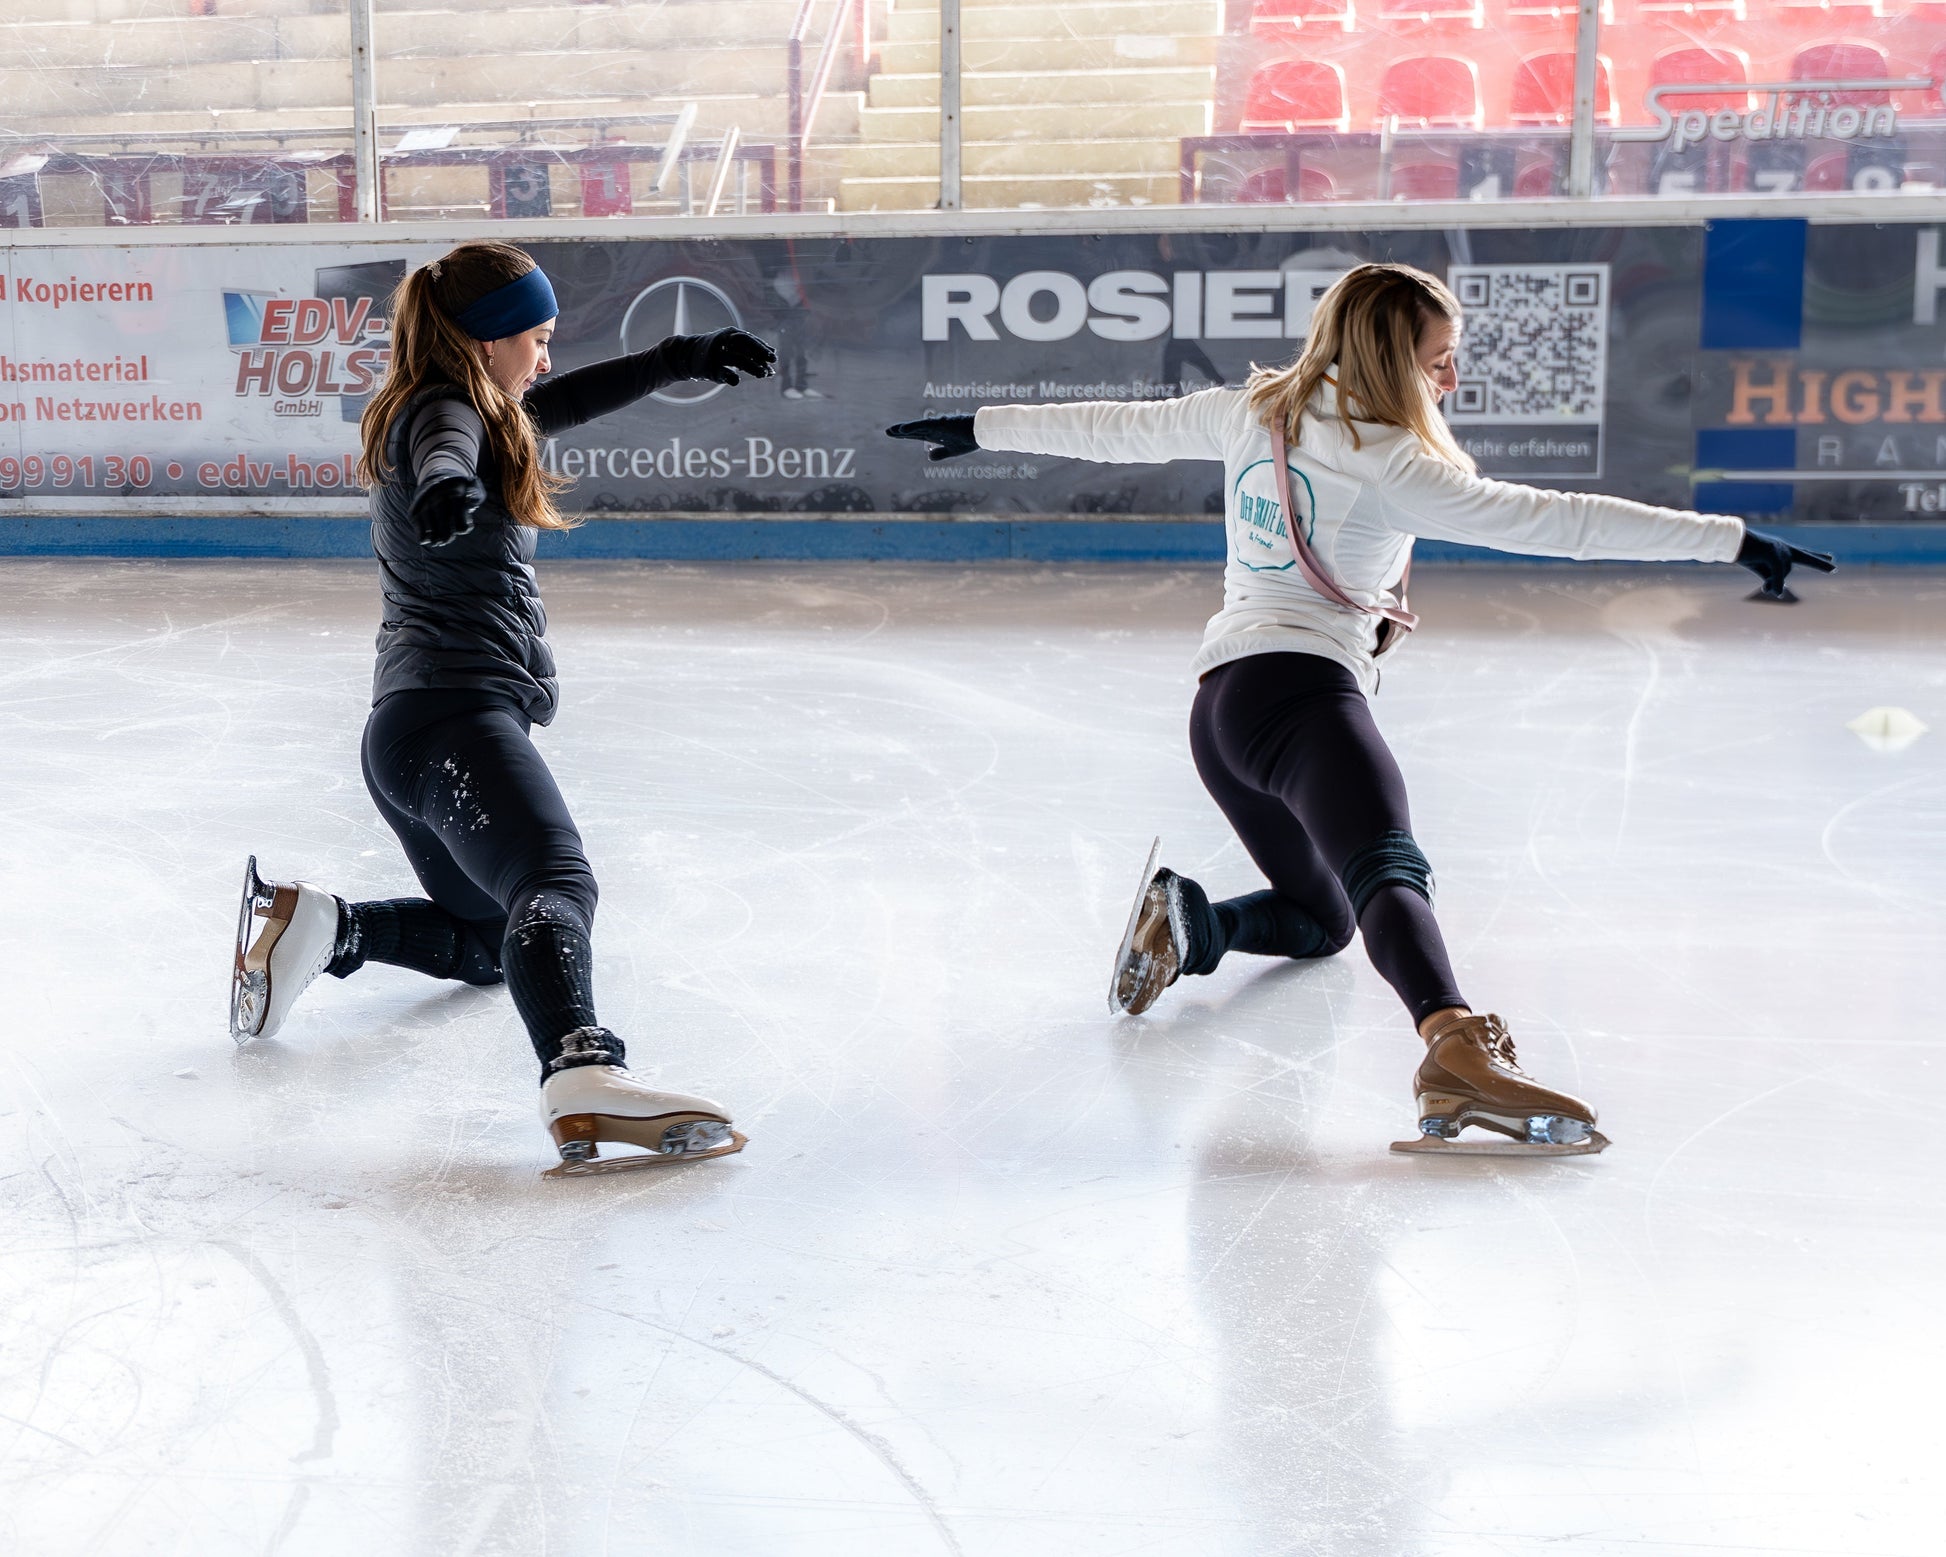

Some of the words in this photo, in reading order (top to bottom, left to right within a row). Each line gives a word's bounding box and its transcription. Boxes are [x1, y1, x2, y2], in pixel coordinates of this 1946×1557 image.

[1610, 78, 1933, 153] Spedition
[16, 275, 154, 310] Kopierern
[259, 297, 386, 345] EDV-
[0, 355, 149, 383] hsmaterial
[922, 381, 1035, 399] Autorisierter
[1039, 380, 1176, 399] Mercedes-Benz
[35, 394, 203, 422] Netzwerken
[273, 400, 323, 417] GmbH
[1508, 437, 1592, 458] erfahren
[197, 452, 360, 489] edv-hol
[922, 462, 1039, 480] www.rosier.de
[1240, 490, 1254, 522] DER
[1254, 496, 1280, 532] SKATE
